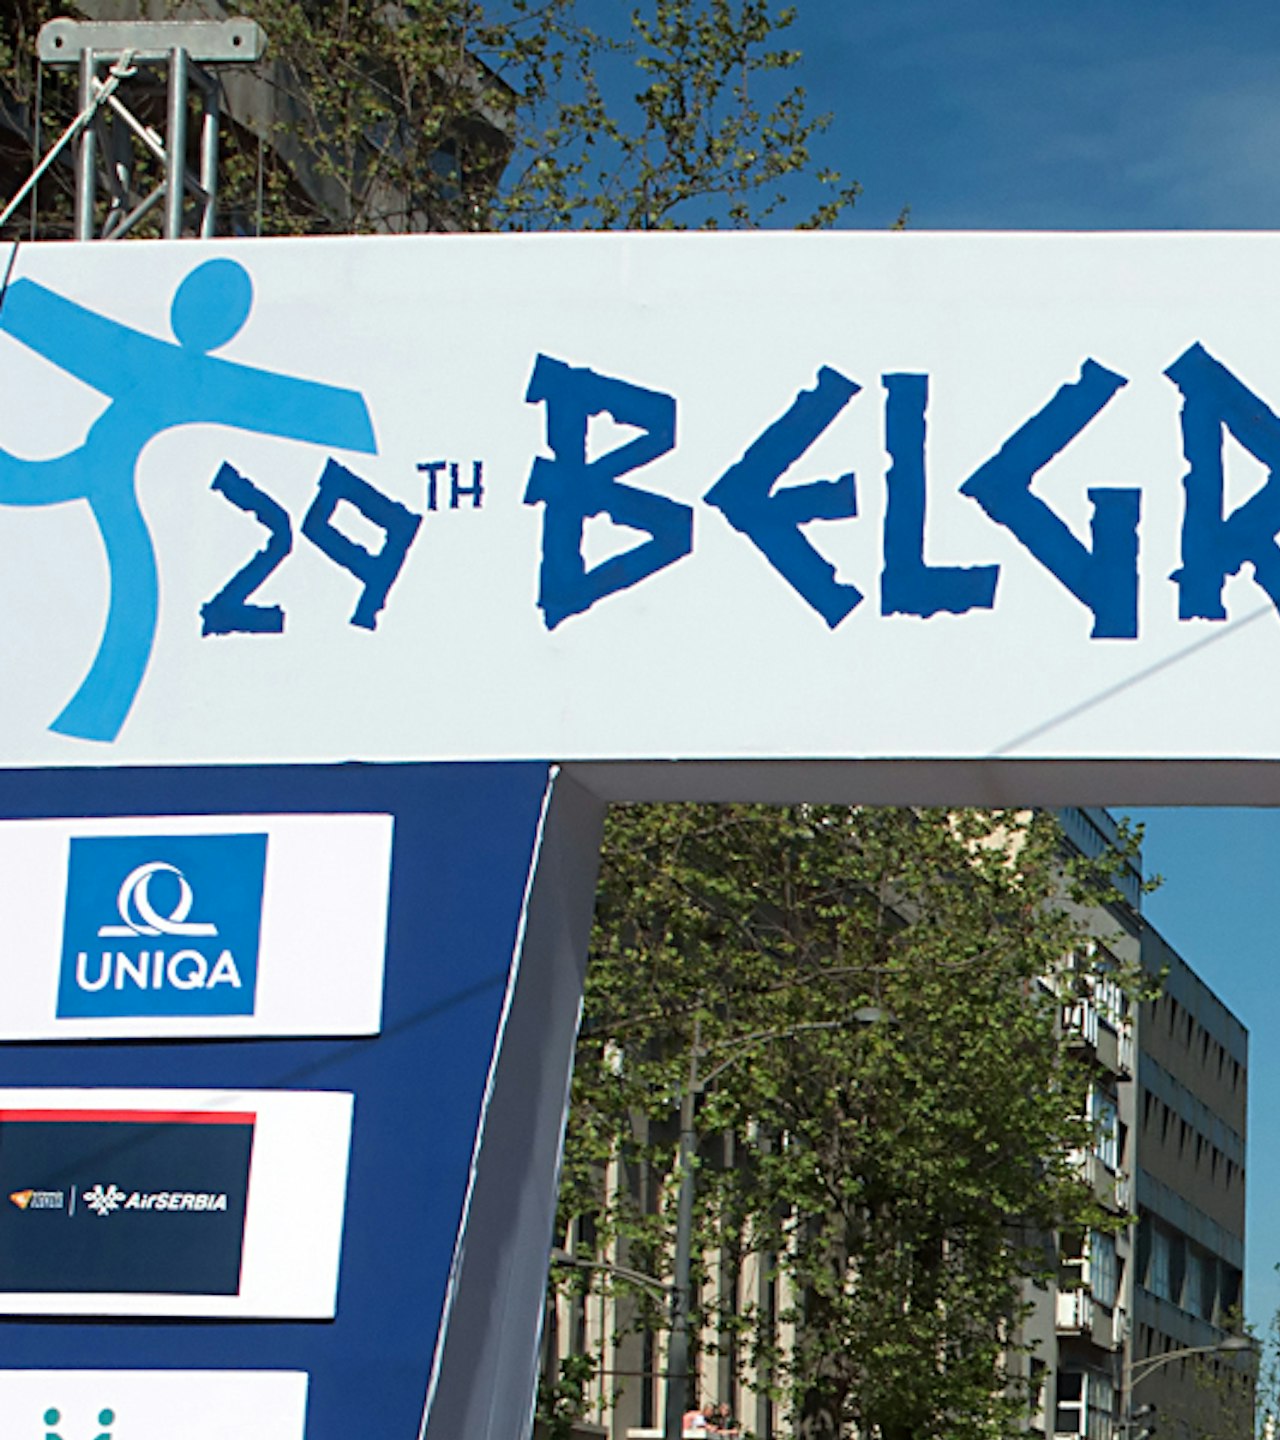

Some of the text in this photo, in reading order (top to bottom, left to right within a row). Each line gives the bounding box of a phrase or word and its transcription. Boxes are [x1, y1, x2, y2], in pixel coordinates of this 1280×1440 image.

[200, 457, 484, 636] 29TH
[76, 949, 242, 992] UNIQA
[124, 1192, 228, 1211] AirSERBIA
